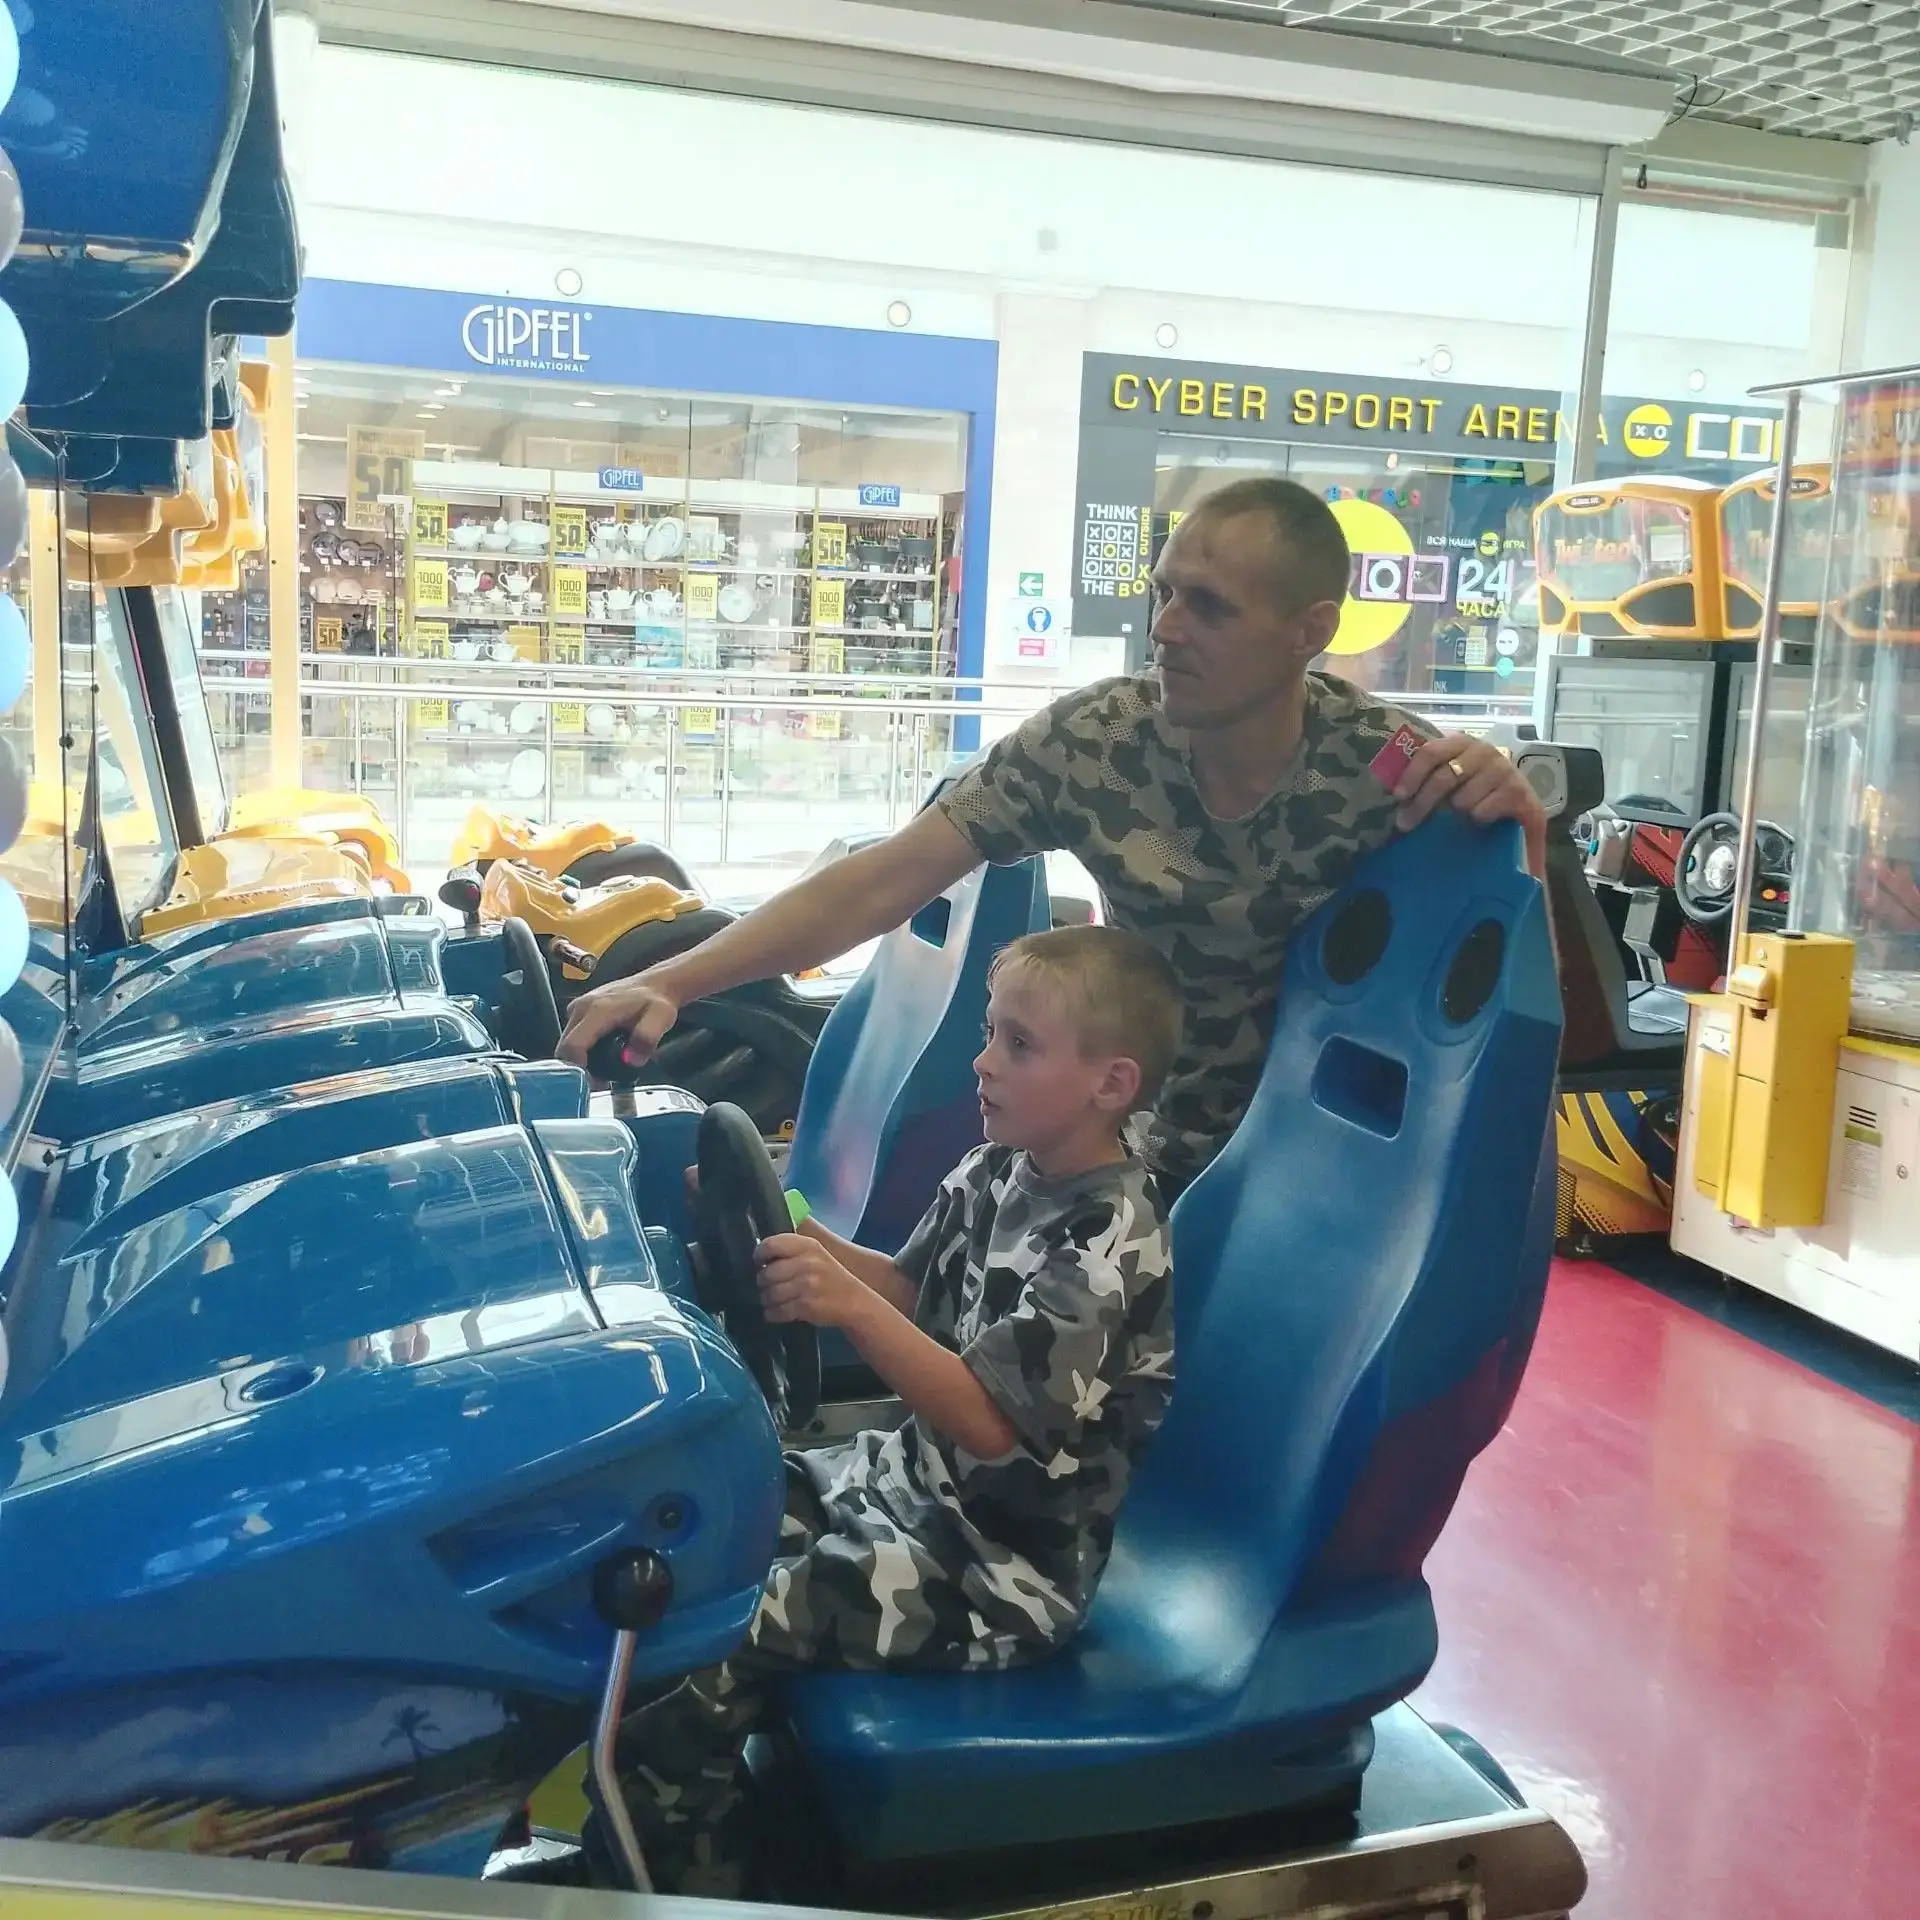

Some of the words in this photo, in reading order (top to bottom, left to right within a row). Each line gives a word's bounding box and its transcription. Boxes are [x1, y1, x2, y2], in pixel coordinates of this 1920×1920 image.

[496, 357, 585, 373] INTERNATIONAL
[1113, 373, 1268, 421] CYBER
[1293, 389, 1443, 433] SPORT
[1086, 503, 1138, 521] THINK
[1139, 506, 1151, 556] OUTSIDE
[1081, 579, 1115, 596] THE
[1458, 557, 1507, 603] 24
[1456, 600, 1507, 617] ЧАСА
